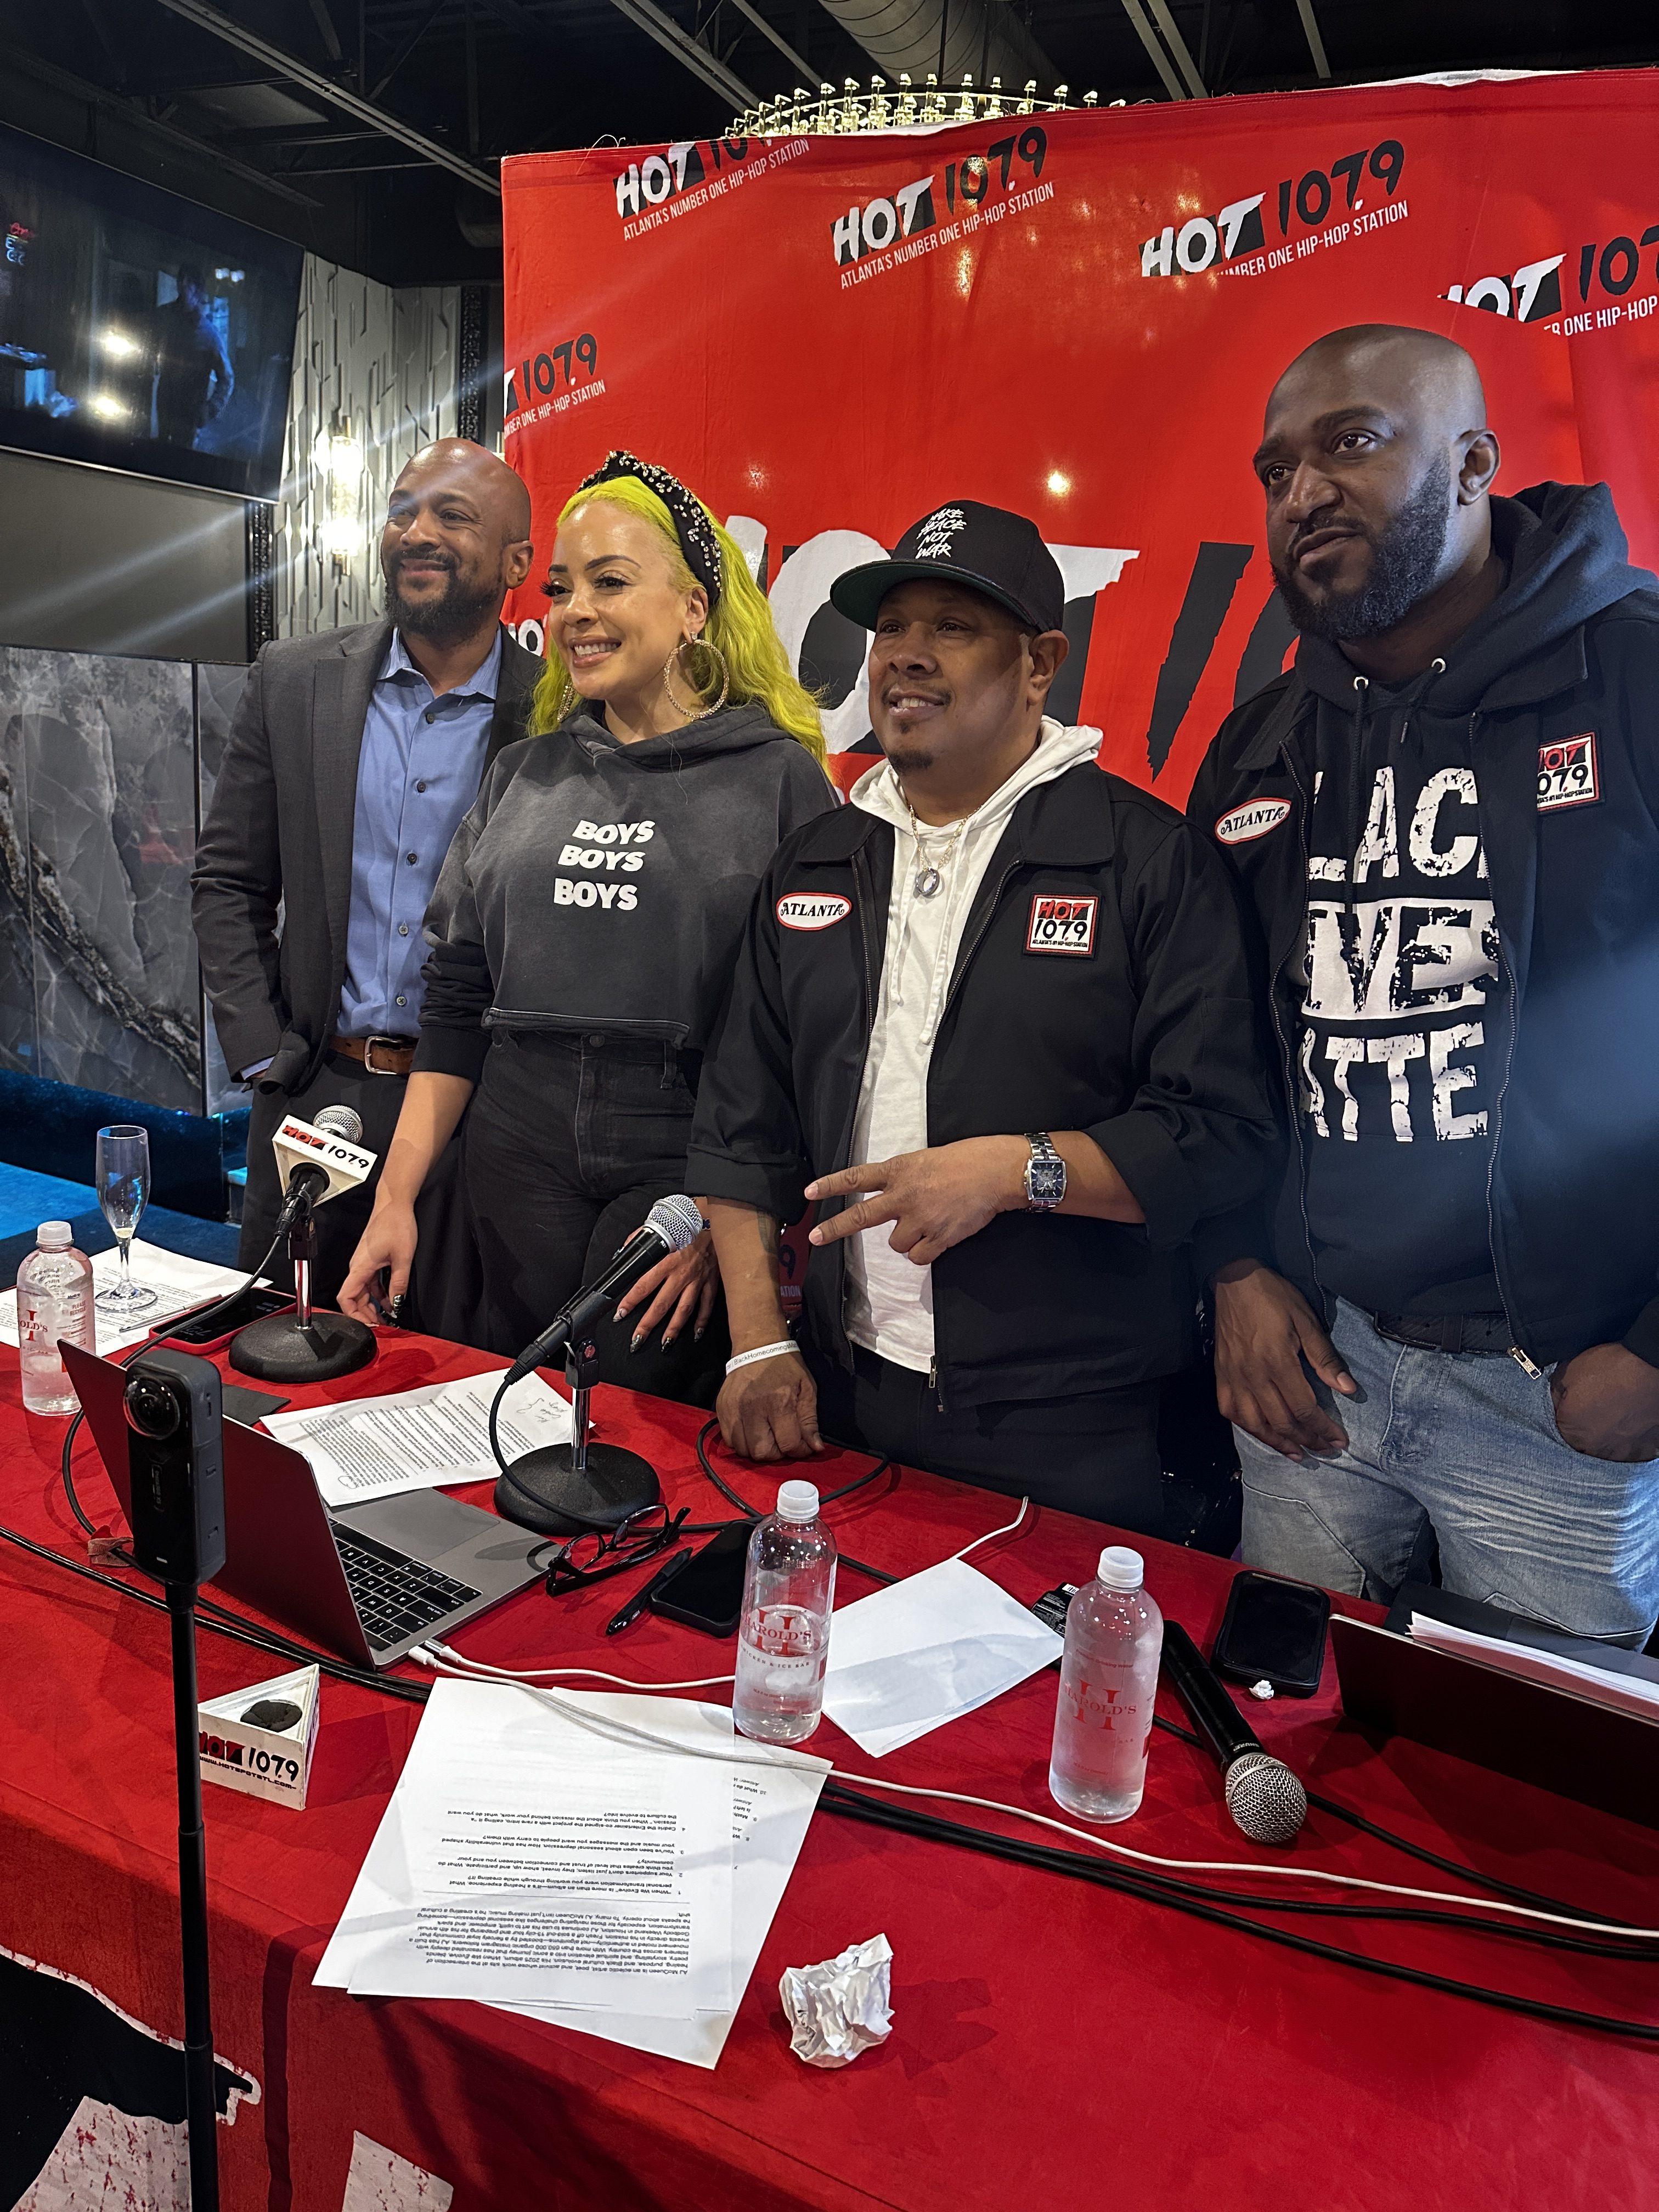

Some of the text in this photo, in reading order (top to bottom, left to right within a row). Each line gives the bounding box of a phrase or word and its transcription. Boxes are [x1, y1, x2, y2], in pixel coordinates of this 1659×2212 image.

[616, 142, 696, 219] HOT
[624, 207, 670, 241] ATLANTA'S
[670, 188, 709, 219] NUMBER
[710, 180, 729, 200] ONE
[729, 158, 767, 189] HIP-HOP
[768, 138, 809, 169] STATION
[833, 174, 935, 266] HOT
[1142, 191, 1267, 277] HOT
[840, 181, 1054, 290] ATLANTA'S NUMBER ONE HIP-HOP STATION
[1268, 245, 1295, 269] ONE
[1297, 222, 1350, 258] HIP-HOP
[1354, 200, 1408, 235] STATION
[1564, 313, 1593, 336] ONE
[1596, 295, 1658, 324] HIP-HOP
[521, 409, 538, 427] ONE
[537, 394, 570, 420] HIP-HOP
[571, 380, 606, 405] STATION
[916, 518, 967, 539] PEACE
[917, 531, 954, 550] NOT
[915, 543, 952, 560] WAR
[572, 820, 656, 845] BOYS
[1221, 806, 1285, 835] ATLANTA
[558, 844, 646, 872] BOYS
[554, 878, 638, 911] BOYS
[781, 902, 845, 917] ATLANTA
[1038, 900, 1092, 920] HOT
[282, 1125, 329, 1150] HOT
[780, 1285, 801, 1297] ATION
[19, 1320, 48, 1332] OLD'S
[744, 1615, 811, 1641] HAROLD'S
[1064, 1684, 1137, 1715] HAROLD'S
